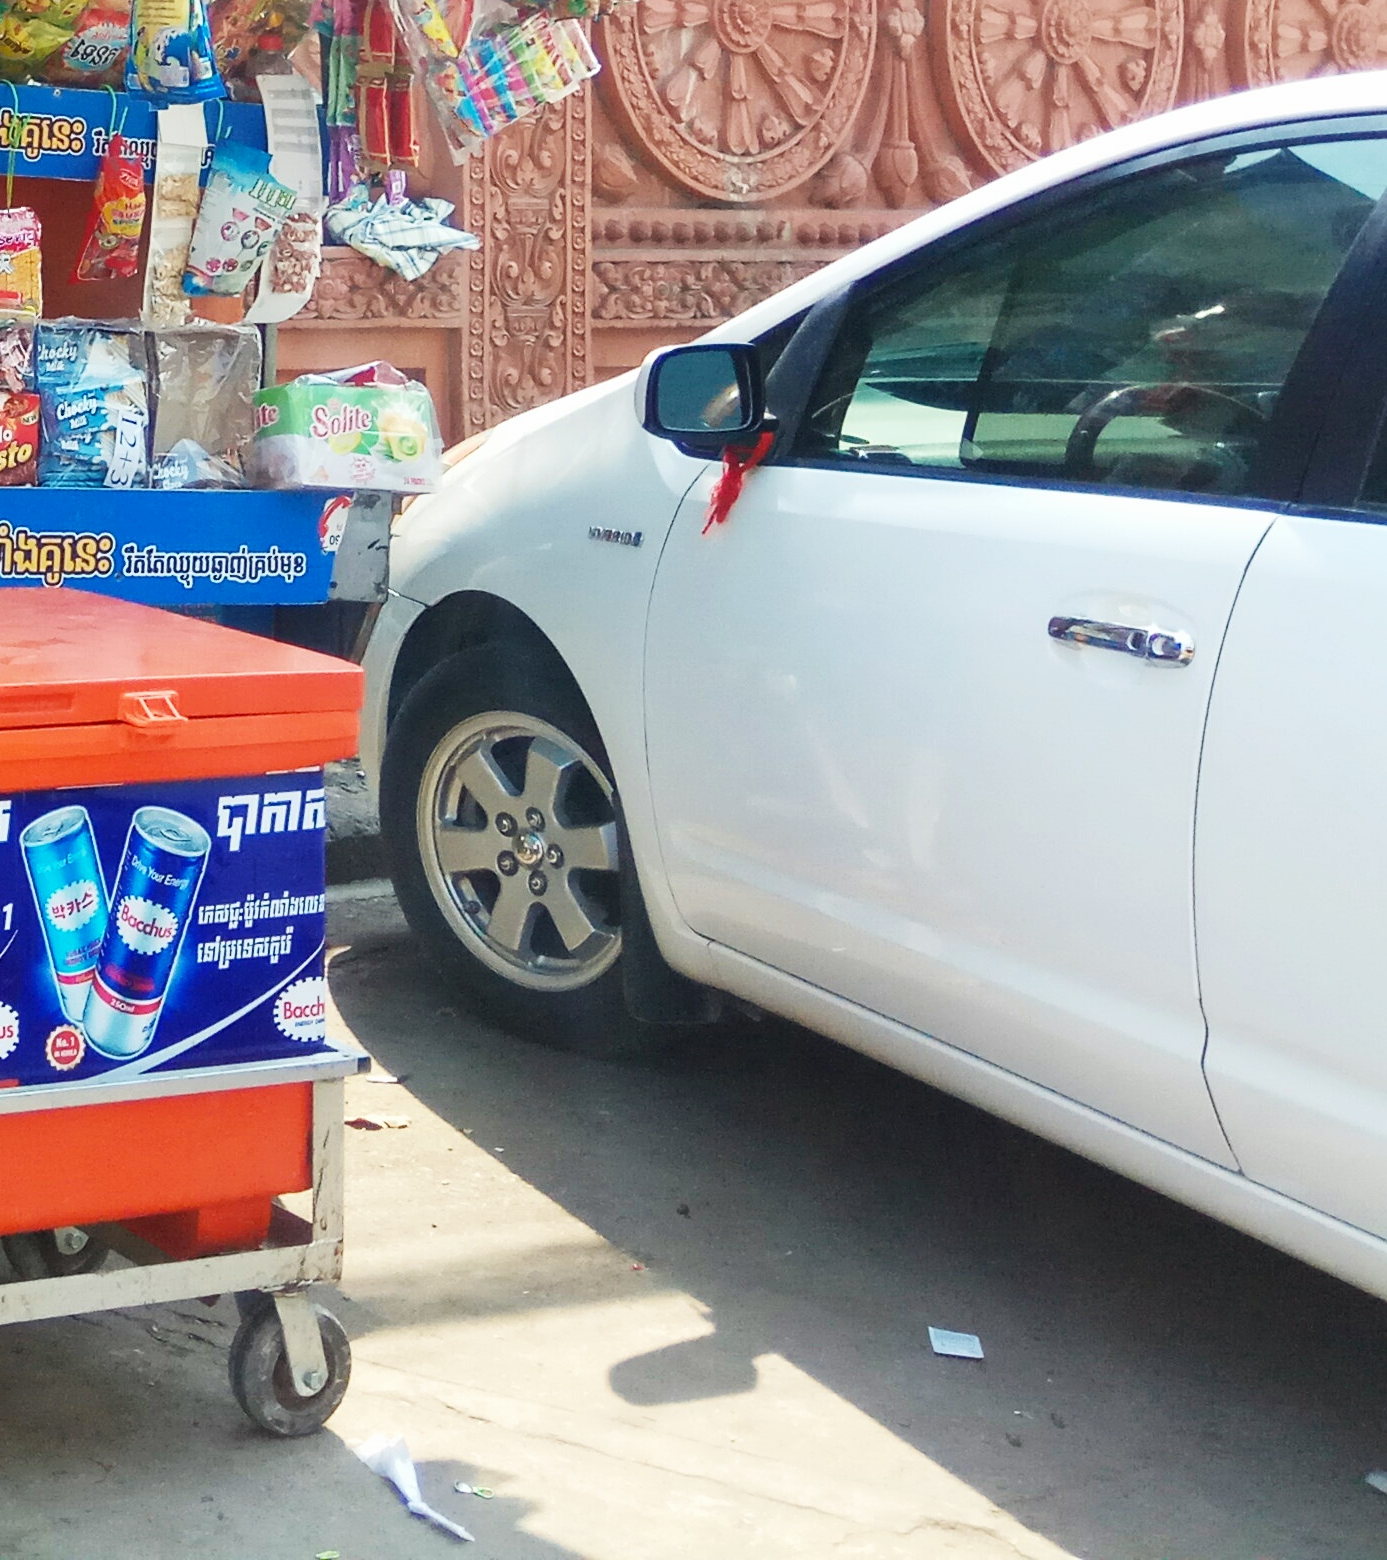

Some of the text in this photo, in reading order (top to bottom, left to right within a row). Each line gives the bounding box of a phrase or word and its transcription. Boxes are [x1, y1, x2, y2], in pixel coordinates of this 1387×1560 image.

[38, 342, 77, 361] hocky
[56, 394, 98, 420] Chocky
[311, 406, 372, 437] Solite
[148, 867, 165, 883] Your
[2, 902, 14, 930] 1
[52, 891, 94, 919] 박카스
[120, 904, 173, 938] Bacchus
[283, 995, 325, 1020] Bacch
[55, 1036, 76, 1048] No. 1
